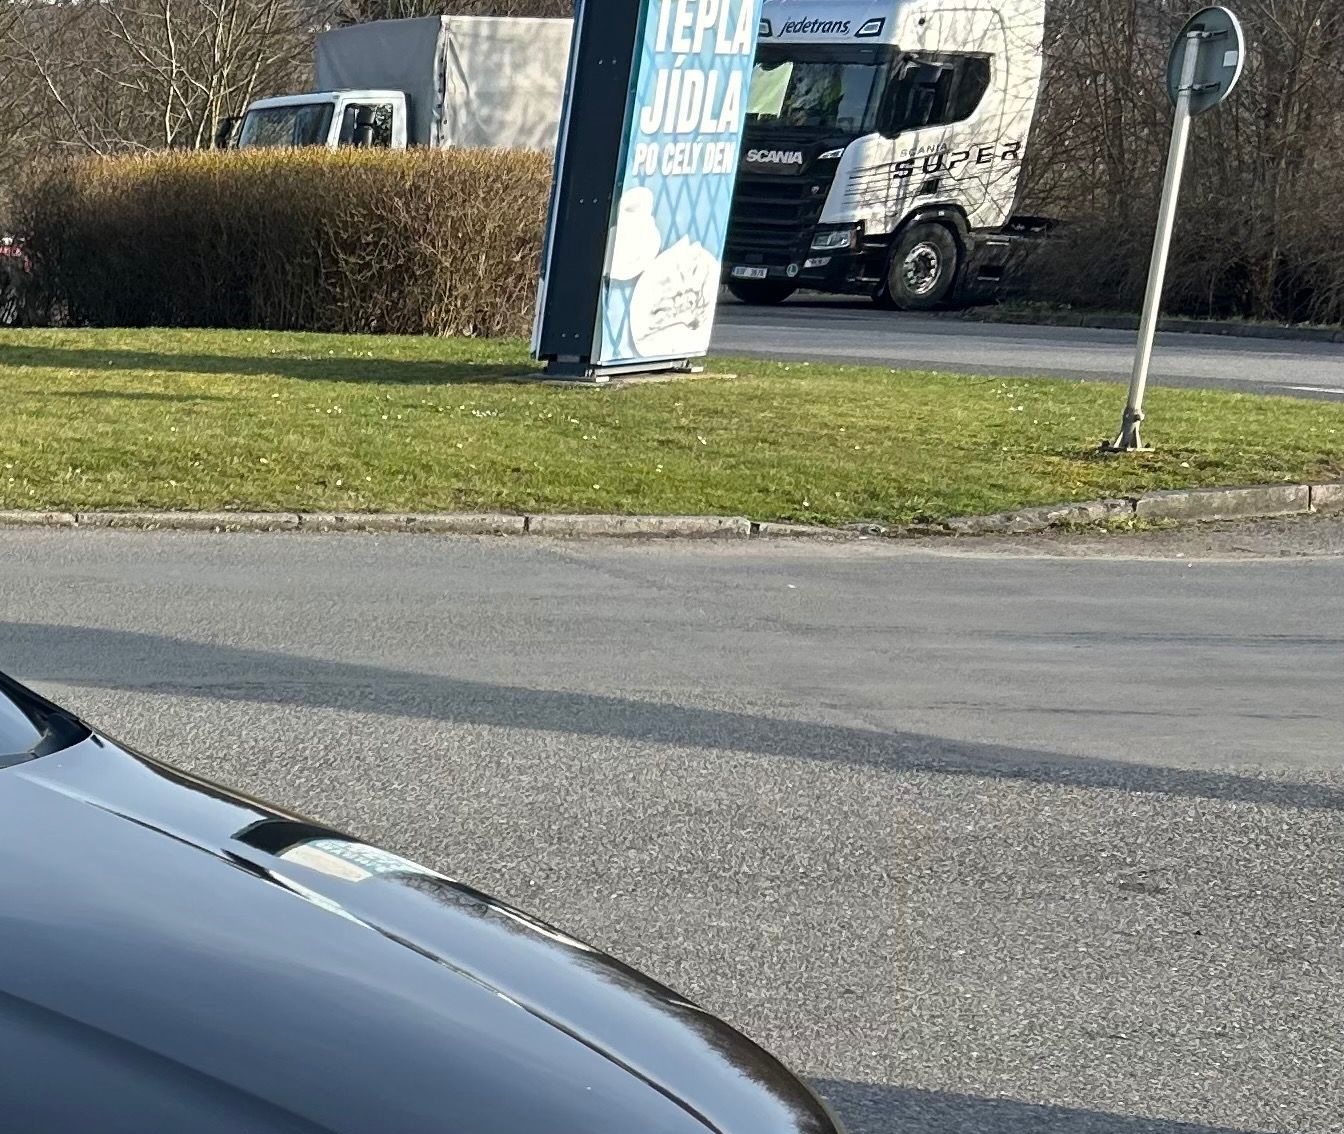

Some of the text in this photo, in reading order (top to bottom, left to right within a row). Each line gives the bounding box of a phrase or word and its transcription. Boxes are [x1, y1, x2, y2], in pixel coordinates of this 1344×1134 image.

[640, 54, 743, 135] JÍDLA
[632, 135, 737, 176] PO CELÝ DEN
[746, 149, 803, 165] SCANIA
[893, 141, 1021, 179] SUPER
